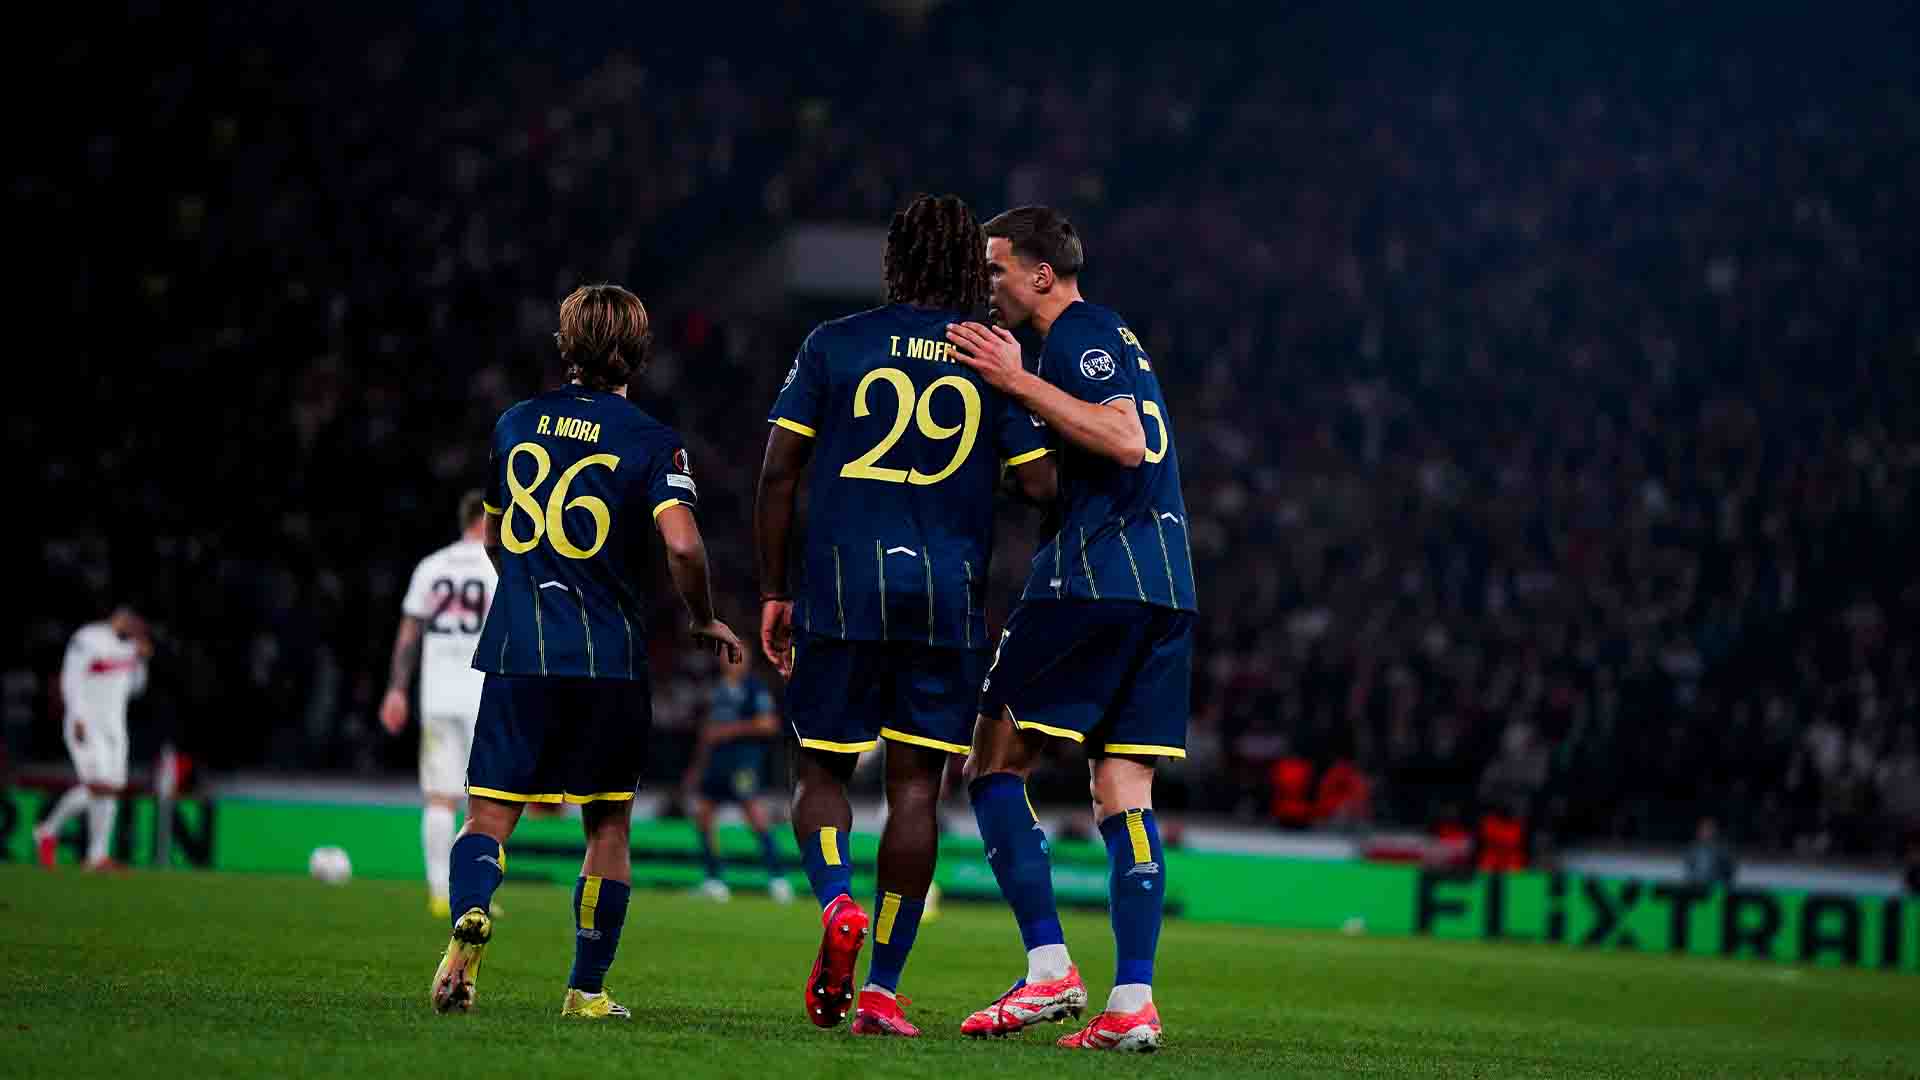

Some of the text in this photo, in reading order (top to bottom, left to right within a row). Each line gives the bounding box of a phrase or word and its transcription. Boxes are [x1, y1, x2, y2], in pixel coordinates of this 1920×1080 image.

[890, 335, 901, 357] T.
[1083, 355, 1111, 370] SUPER
[1088, 363, 1112, 377] BOCK
[536, 415, 601, 443] R. MORA
[840, 367, 981, 485] 29
[501, 442, 620, 559] 86
[426, 578, 486, 634] 29
